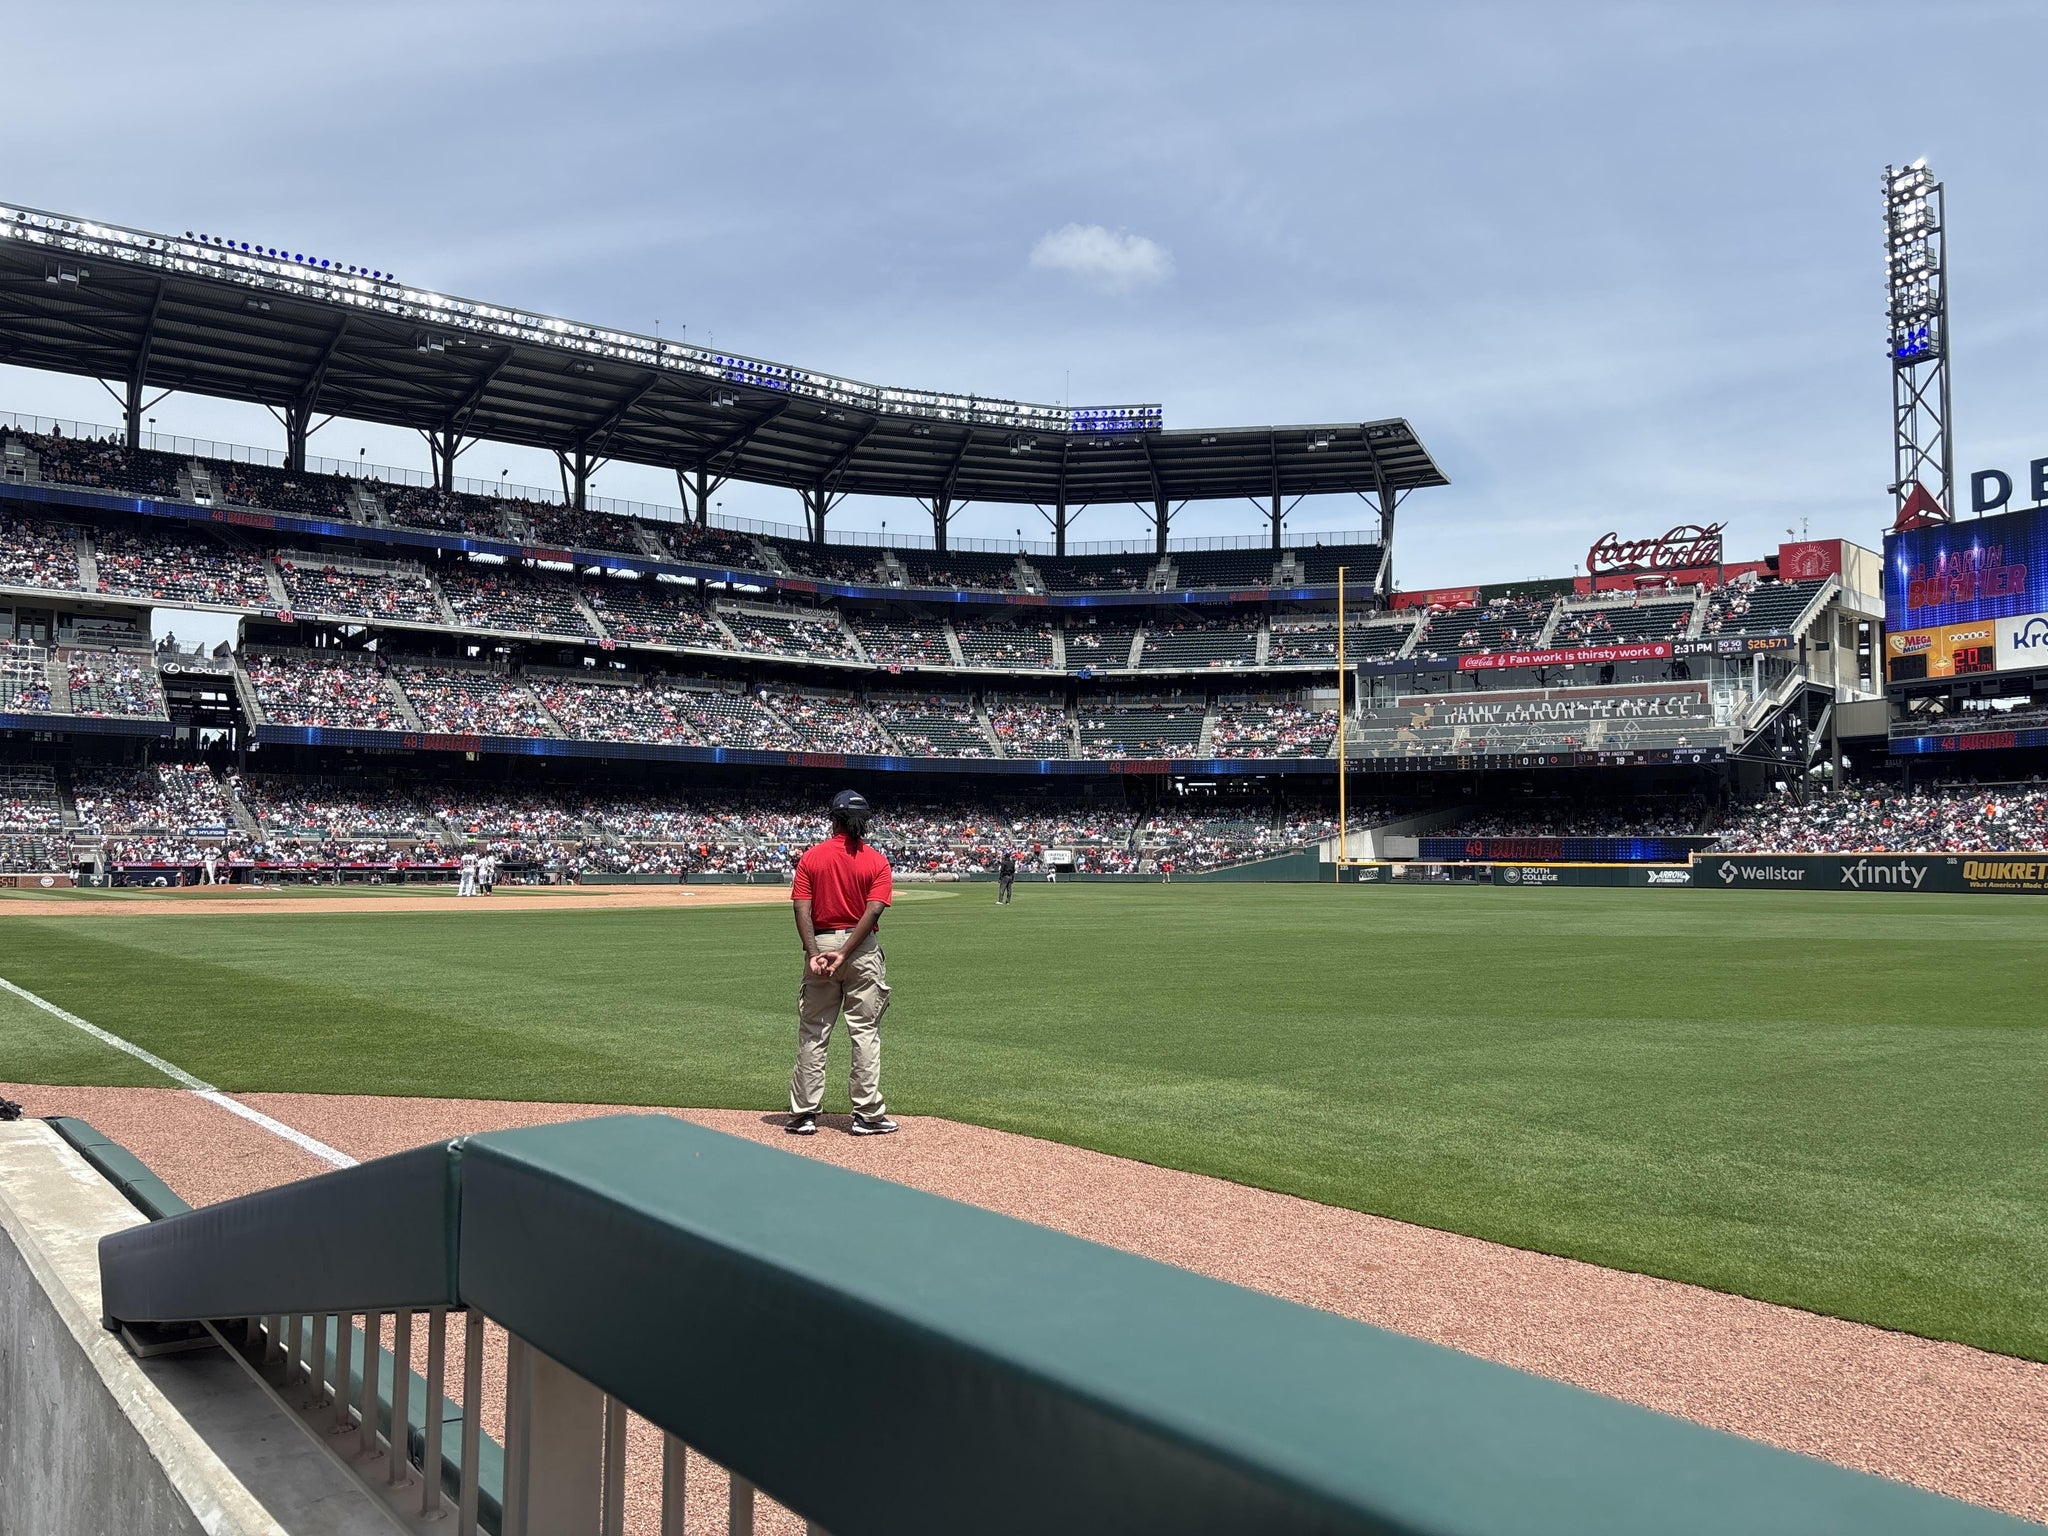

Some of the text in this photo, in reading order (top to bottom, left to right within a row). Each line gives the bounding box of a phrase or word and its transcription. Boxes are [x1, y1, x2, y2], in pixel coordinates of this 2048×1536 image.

[1586, 521, 1728, 574] Coca-Cola
[1933, 545, 2002, 576] AARON
[1908, 564, 2027, 609] BUMMER
[277, 610, 293, 622] 41
[599, 639, 615, 650] 44
[1747, 638, 1788, 650] $26,571
[1905, 636, 1931, 646] MEGA
[1674, 643, 1712, 654] 2:31 PM
[1510, 656, 1529, 664] Fan
[1532, 654, 1562, 662] work
[1565, 653, 1574, 661] is
[1577, 650, 1615, 660] thirsty
[1620, 647, 1650, 657] work
[1955, 648, 1978, 665] 20
[181, 666, 229, 675] LEXUS
[1956, 664, 1992, 673] MILLION
[1445, 696, 1691, 724] HANK AARON TERRACE
[1959, 732, 2015, 750] BUMMER
[1523, 757, 1529, 765] 0
[1538, 757, 1544, 765] 0
[1616, 756, 1625, 765] 19
[1693, 754, 1700, 763] 0
[1466, 839, 1562, 857] 49 BUMMER
[1658, 871, 1683, 879] ARROW
[1740, 866, 1805, 881] Wellstar
[1840, 859, 1928, 888] xfinity
